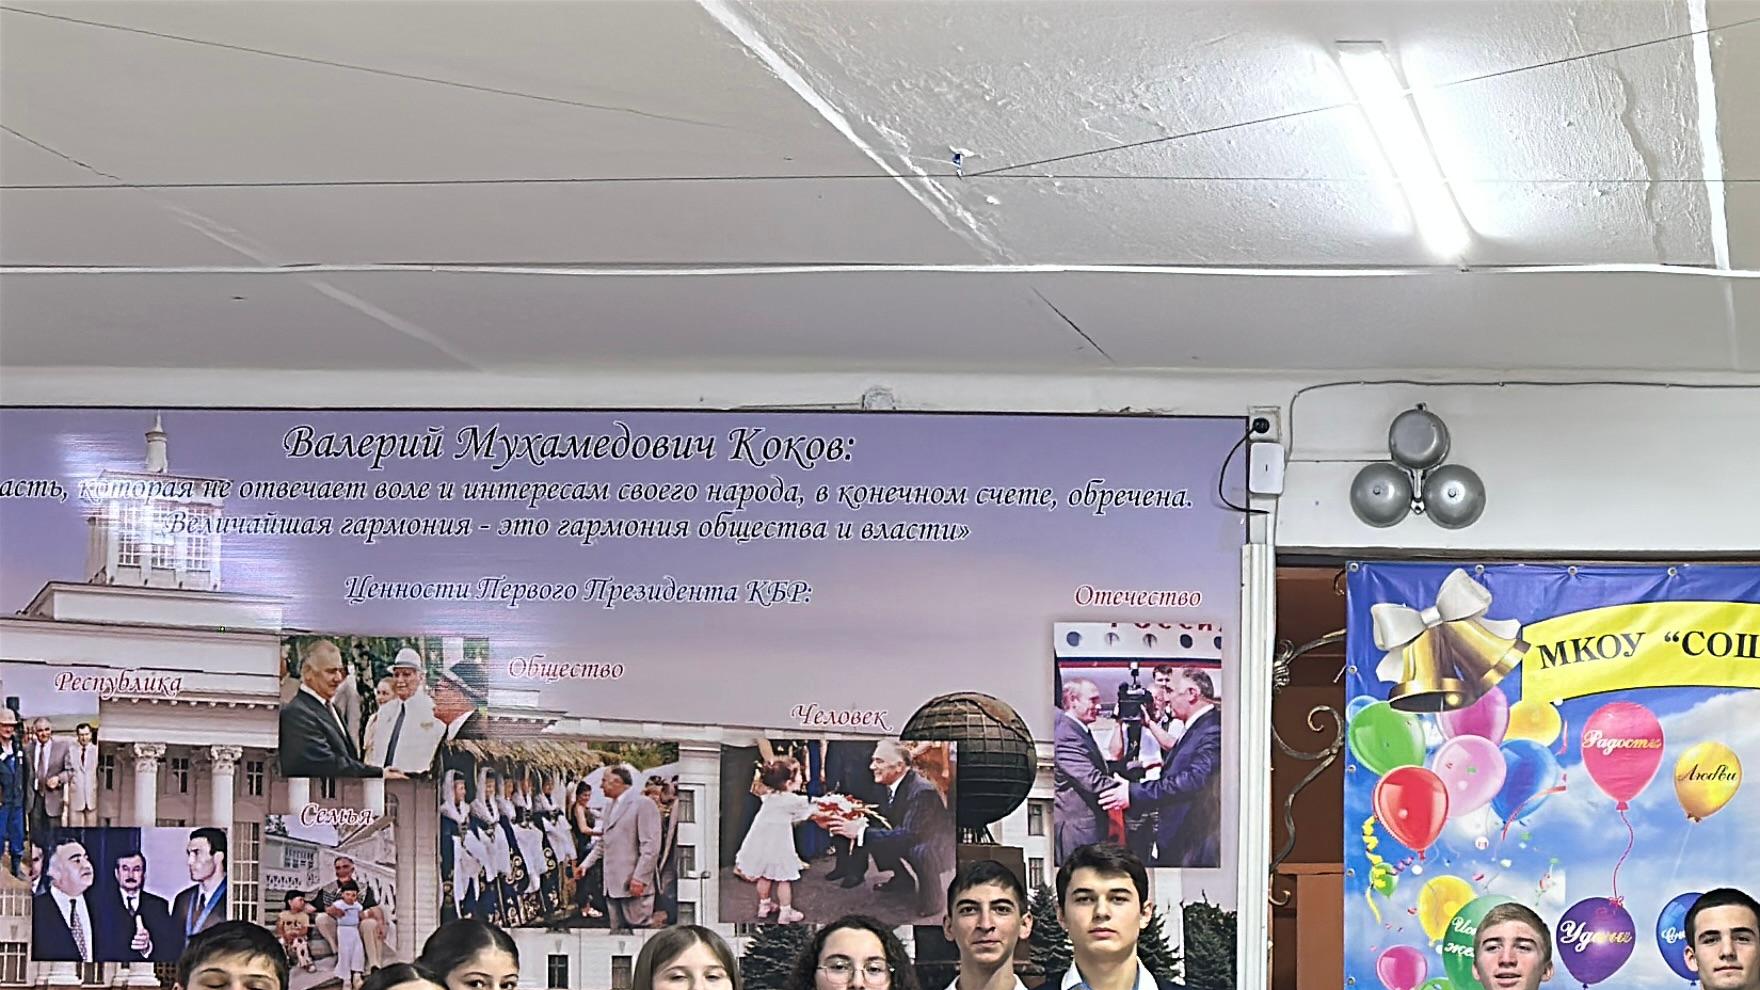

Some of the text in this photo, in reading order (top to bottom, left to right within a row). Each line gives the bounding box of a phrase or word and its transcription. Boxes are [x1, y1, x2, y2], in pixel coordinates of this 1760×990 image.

[284, 422, 855, 470] Валерий Мухамедович Коков:
[79, 478, 193, 506] которая
[203, 481, 231, 499] не
[239, 480, 366, 500] отвечает
[374, 481, 431, 500] воле
[439, 482, 453, 500] и
[462, 482, 609, 509] интересам
[618, 482, 698, 502] своего
[707, 475, 804, 508] народа,
[815, 484, 829, 502] в
[838, 485, 967, 508] конечном
[976, 486, 1058, 509] счете,
[1068, 479, 1193, 514] обречена.
[166, 510, 331, 535] Величайшая
[341, 518, 472, 544] гармония
[497, 517, 549, 537] это
[557, 518, 689, 545] гармония
[698, 511, 827, 544] общества
[835, 521, 852, 539] и
[861, 520, 971, 541] власти»
[344, 575, 813, 608] Ценности Первого Президента КБР:
[1075, 583, 1202, 609] Отечество
[1537, 631, 1647, 670] МКОУ
[507, 654, 625, 682] Общество
[55, 671, 182, 698] Республика
[790, 703, 894, 732] Человек
[1677, 764, 1738, 782] Любви
[300, 803, 374, 828] Семья
